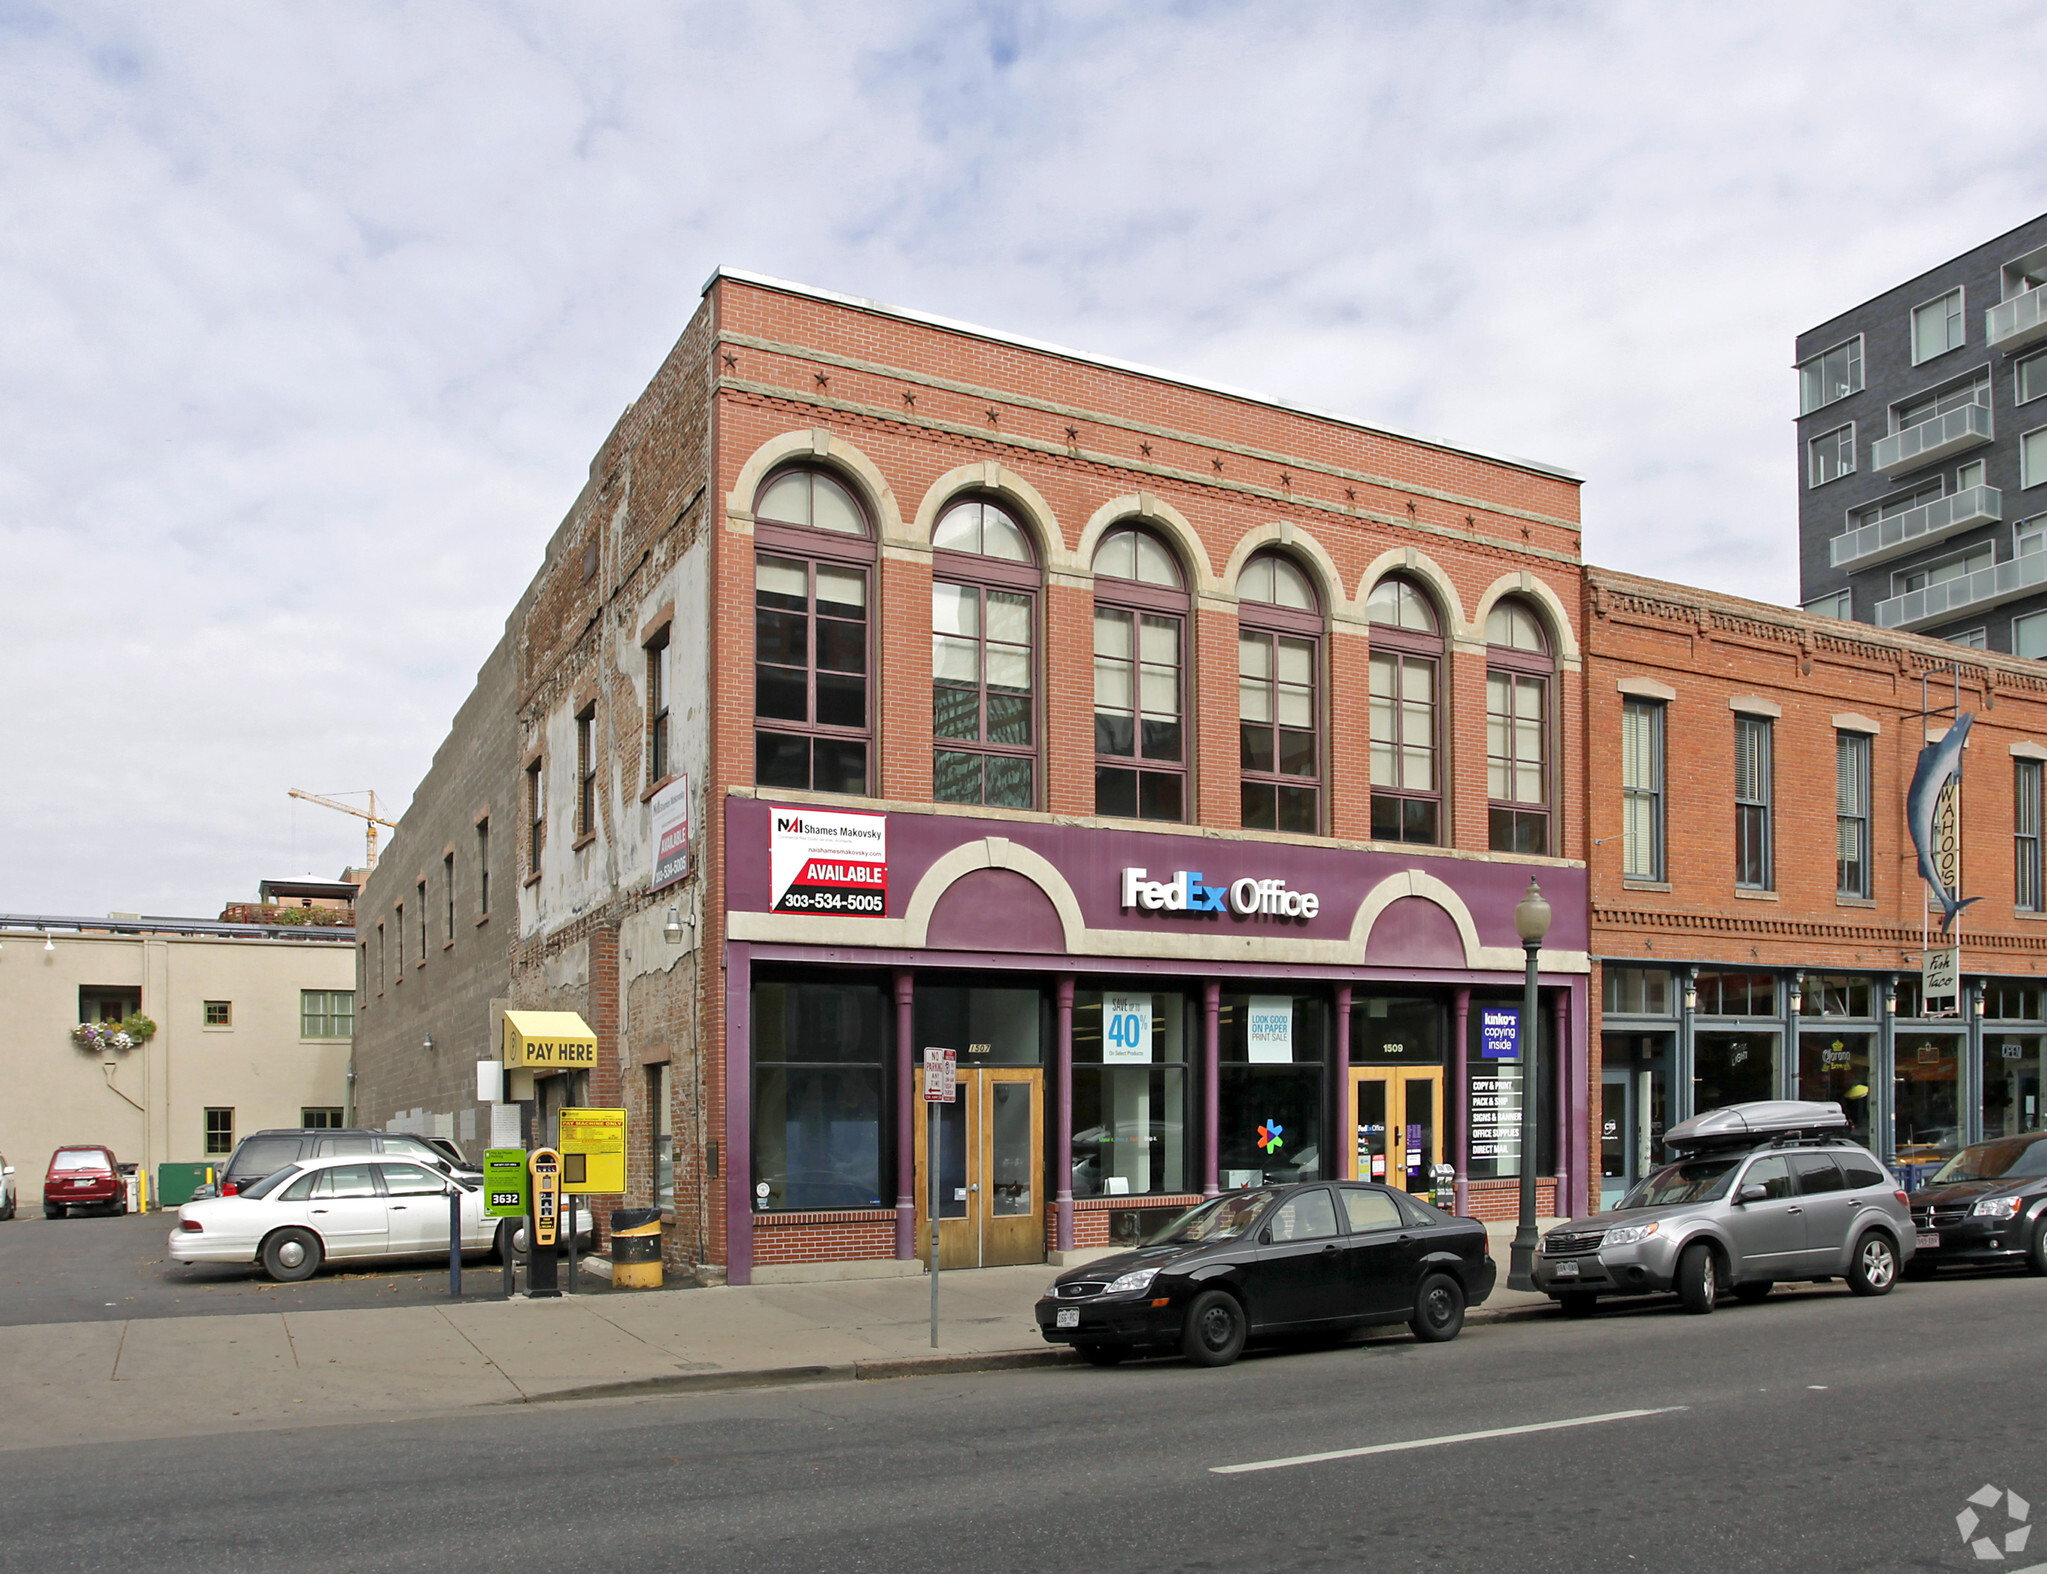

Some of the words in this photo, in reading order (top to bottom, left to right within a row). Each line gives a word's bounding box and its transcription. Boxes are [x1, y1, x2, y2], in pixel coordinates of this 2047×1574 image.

[777, 816, 803, 833] NAI
[804, 825, 838, 836] Shames
[840, 827, 882, 840] Makovsky
[661, 827, 686, 854] AVAILABLE
[1940, 785, 1955, 886] WAHOO'S
[808, 847, 882, 857] naishamesmakovsky.com
[807, 864, 883, 883] AVAILABLE
[1122, 867, 1228, 912] FedEx
[1230, 877, 1319, 919] Office
[785, 893, 883, 911] 303-534-5005
[1929, 954, 1951, 970] Fish
[1927, 971, 1953, 988] Taco
[1112, 998, 1128, 1011] SAVE
[1252, 1015, 1269, 1024] LOOK
[1270, 1015, 1288, 1024] GOOD
[1484, 1013, 1516, 1026] kinko's
[1252, 1024, 1263, 1033] ON
[1264, 1024, 1288, 1033] PAPER
[1484, 1026, 1516, 1038] copying
[1252, 1033, 1270, 1041] PRINT
[1271, 1033, 1288, 1041] SALE
[970, 1044, 990, 1052] 1507
[1383, 1043, 1404, 1053] 1509
[1488, 1038, 1512, 1050] inside
[527, 1043, 554, 1060] PAY
[558, 1044, 593, 1061] HERE
[931, 1052, 940, 1061] NO
[926, 1062, 943, 1072] PARKING
[1473, 1081, 1489, 1090] COPY
[1489, 1081, 1494, 1090] &
[1495, 1081, 1512, 1090] PRINT
[1473, 1097, 1489, 1106] PACK
[1489, 1097, 1494, 1106] &
[1495, 1097, 1508, 1106] SHIP
[1473, 1113, 1491, 1122] SIGNS
[1491, 1113, 1497, 1122] &
[1473, 1129, 1492, 1138] OFFICE
[1493, 1129, 1519, 1138] SUPPLIES
[1473, 1145, 1493, 1154] DIRECT
[1494, 1145, 1508, 1153] MAIL
[492, 1194, 518, 1204] 3632
